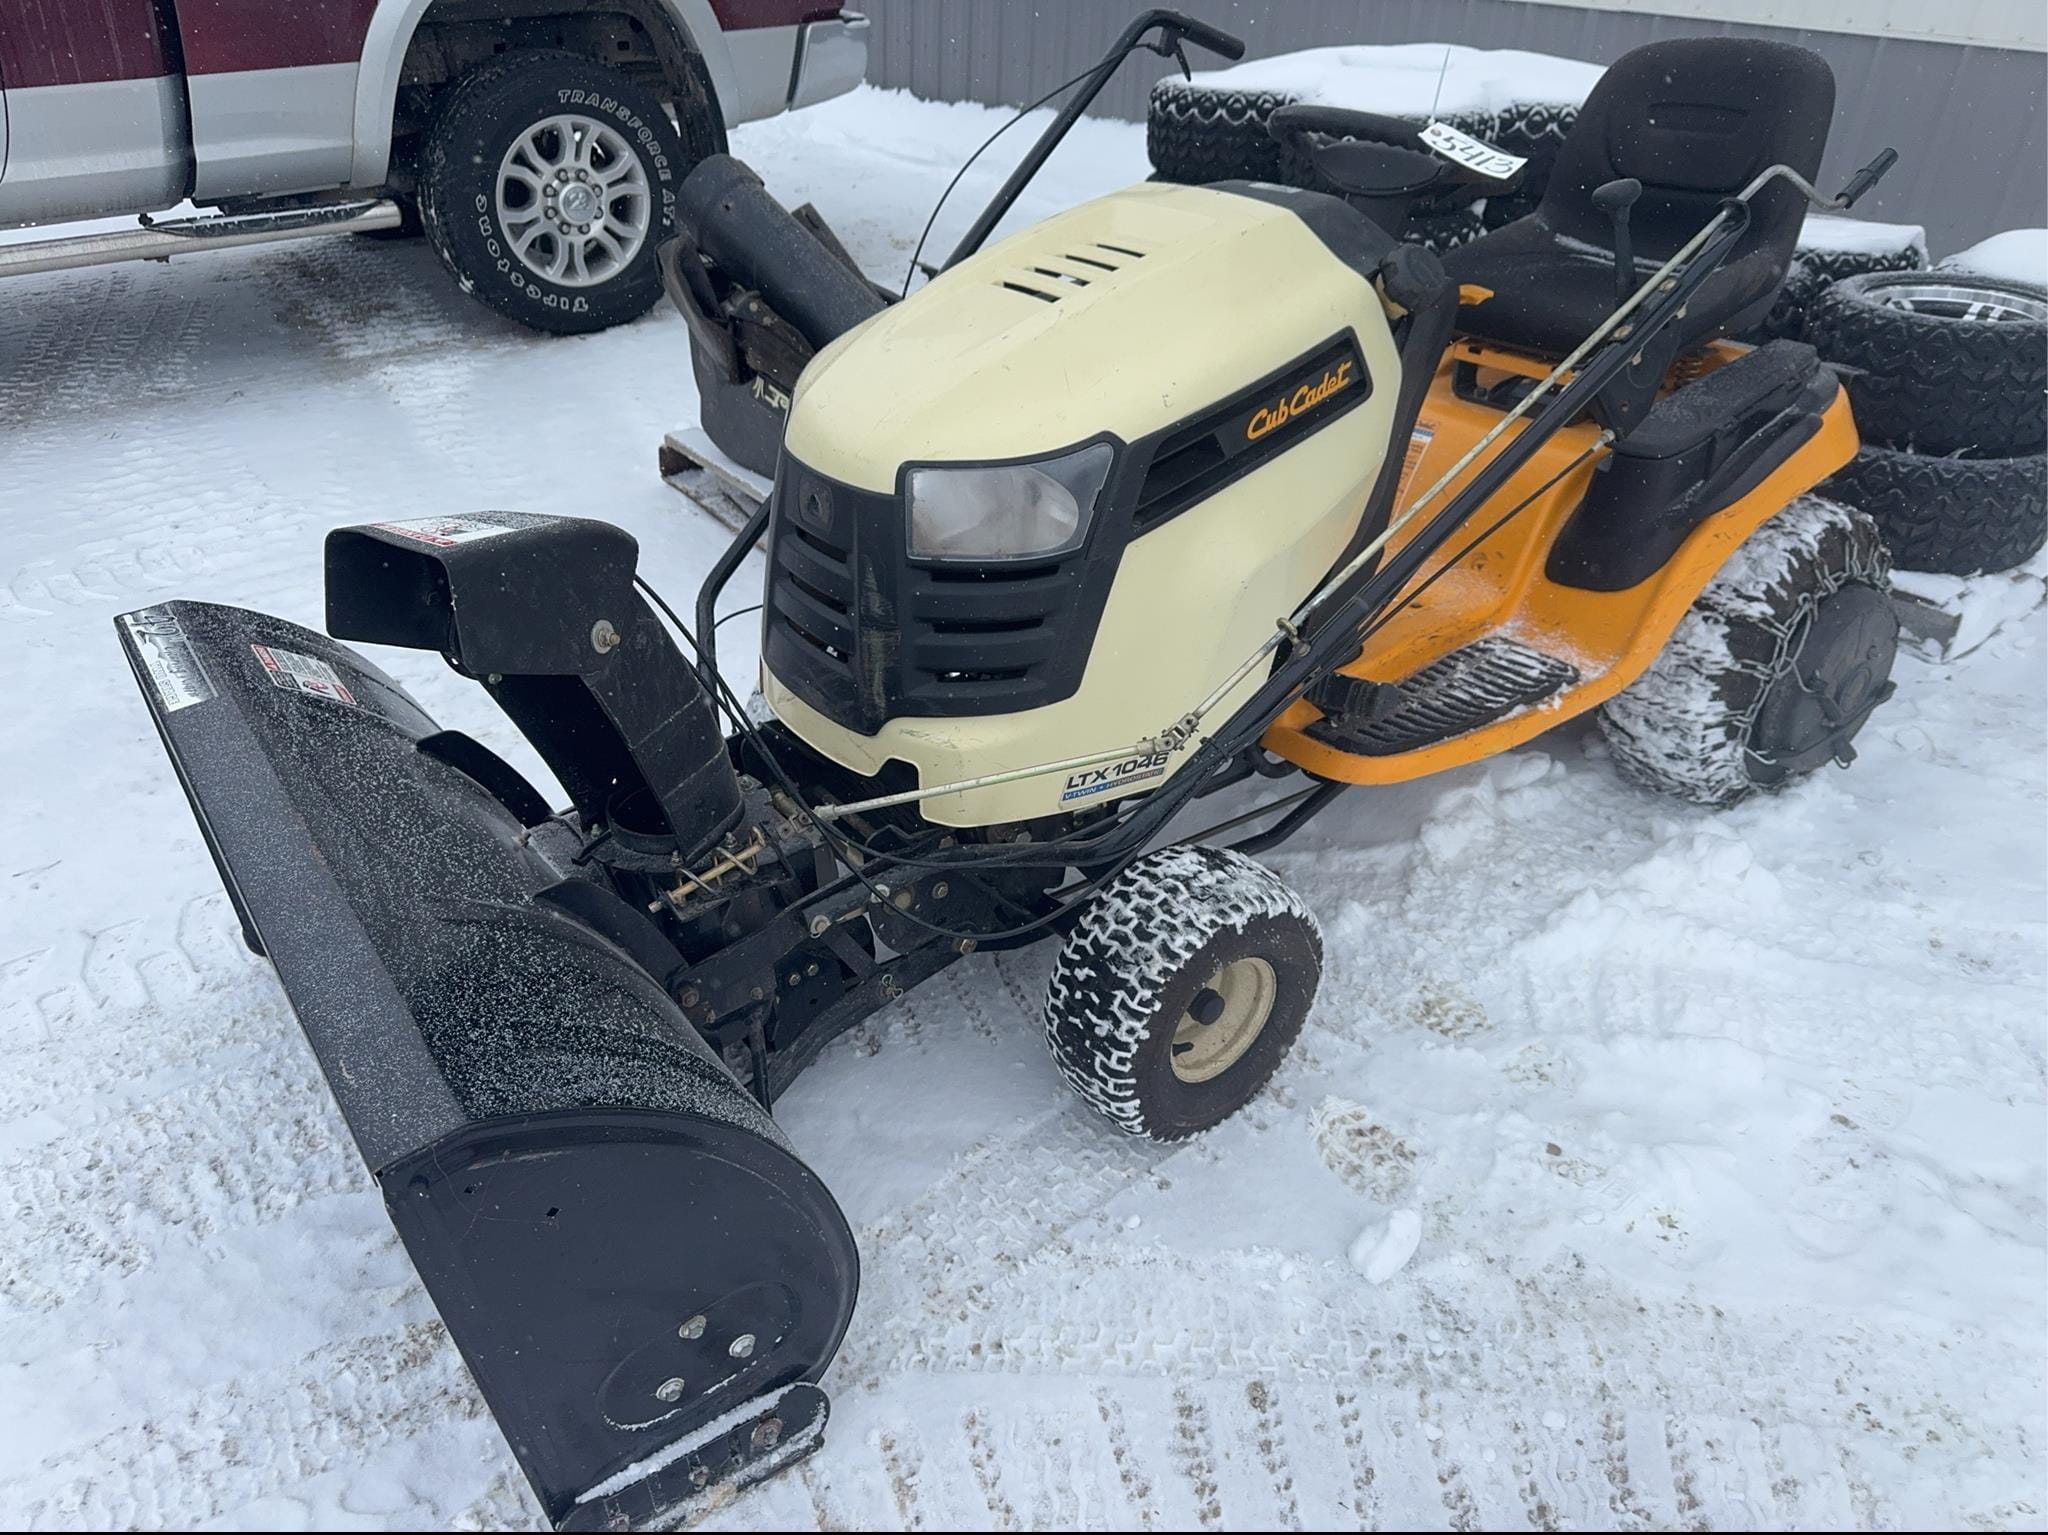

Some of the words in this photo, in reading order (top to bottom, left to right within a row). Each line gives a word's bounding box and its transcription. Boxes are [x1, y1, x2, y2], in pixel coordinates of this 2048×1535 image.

[558, 89, 672, 181] TRANSFORCE
[1431, 136, 1514, 174] 5413
[1247, 397, 1289, 440] Cub
[1289, 361, 1352, 416] Cadet
[159, 680, 180, 705] STAGE
[1066, 767, 1110, 789] LTX
[1112, 752, 1169, 776] 1046
